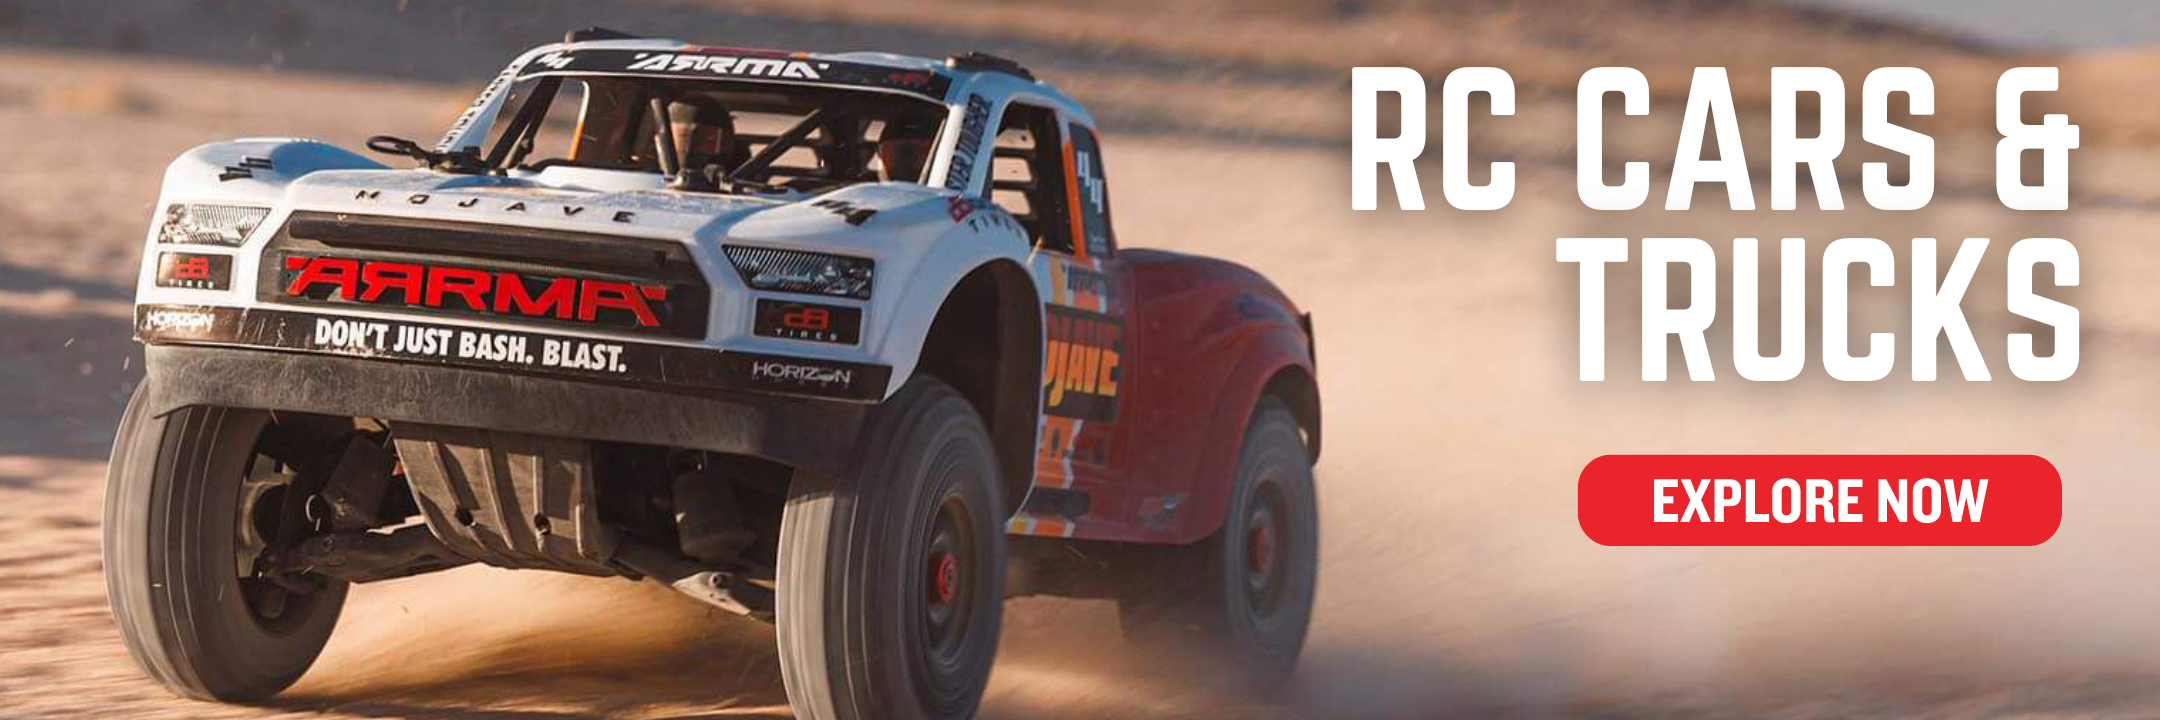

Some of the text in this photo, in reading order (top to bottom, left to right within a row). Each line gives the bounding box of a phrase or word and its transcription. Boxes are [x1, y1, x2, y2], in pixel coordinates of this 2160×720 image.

[626, 53, 830, 79] ARRMA
[354, 189, 636, 224] MOJAVE
[285, 256, 667, 327] ARRMA
[315, 318, 627, 372] DON'T JUST BASH. BLAST.
